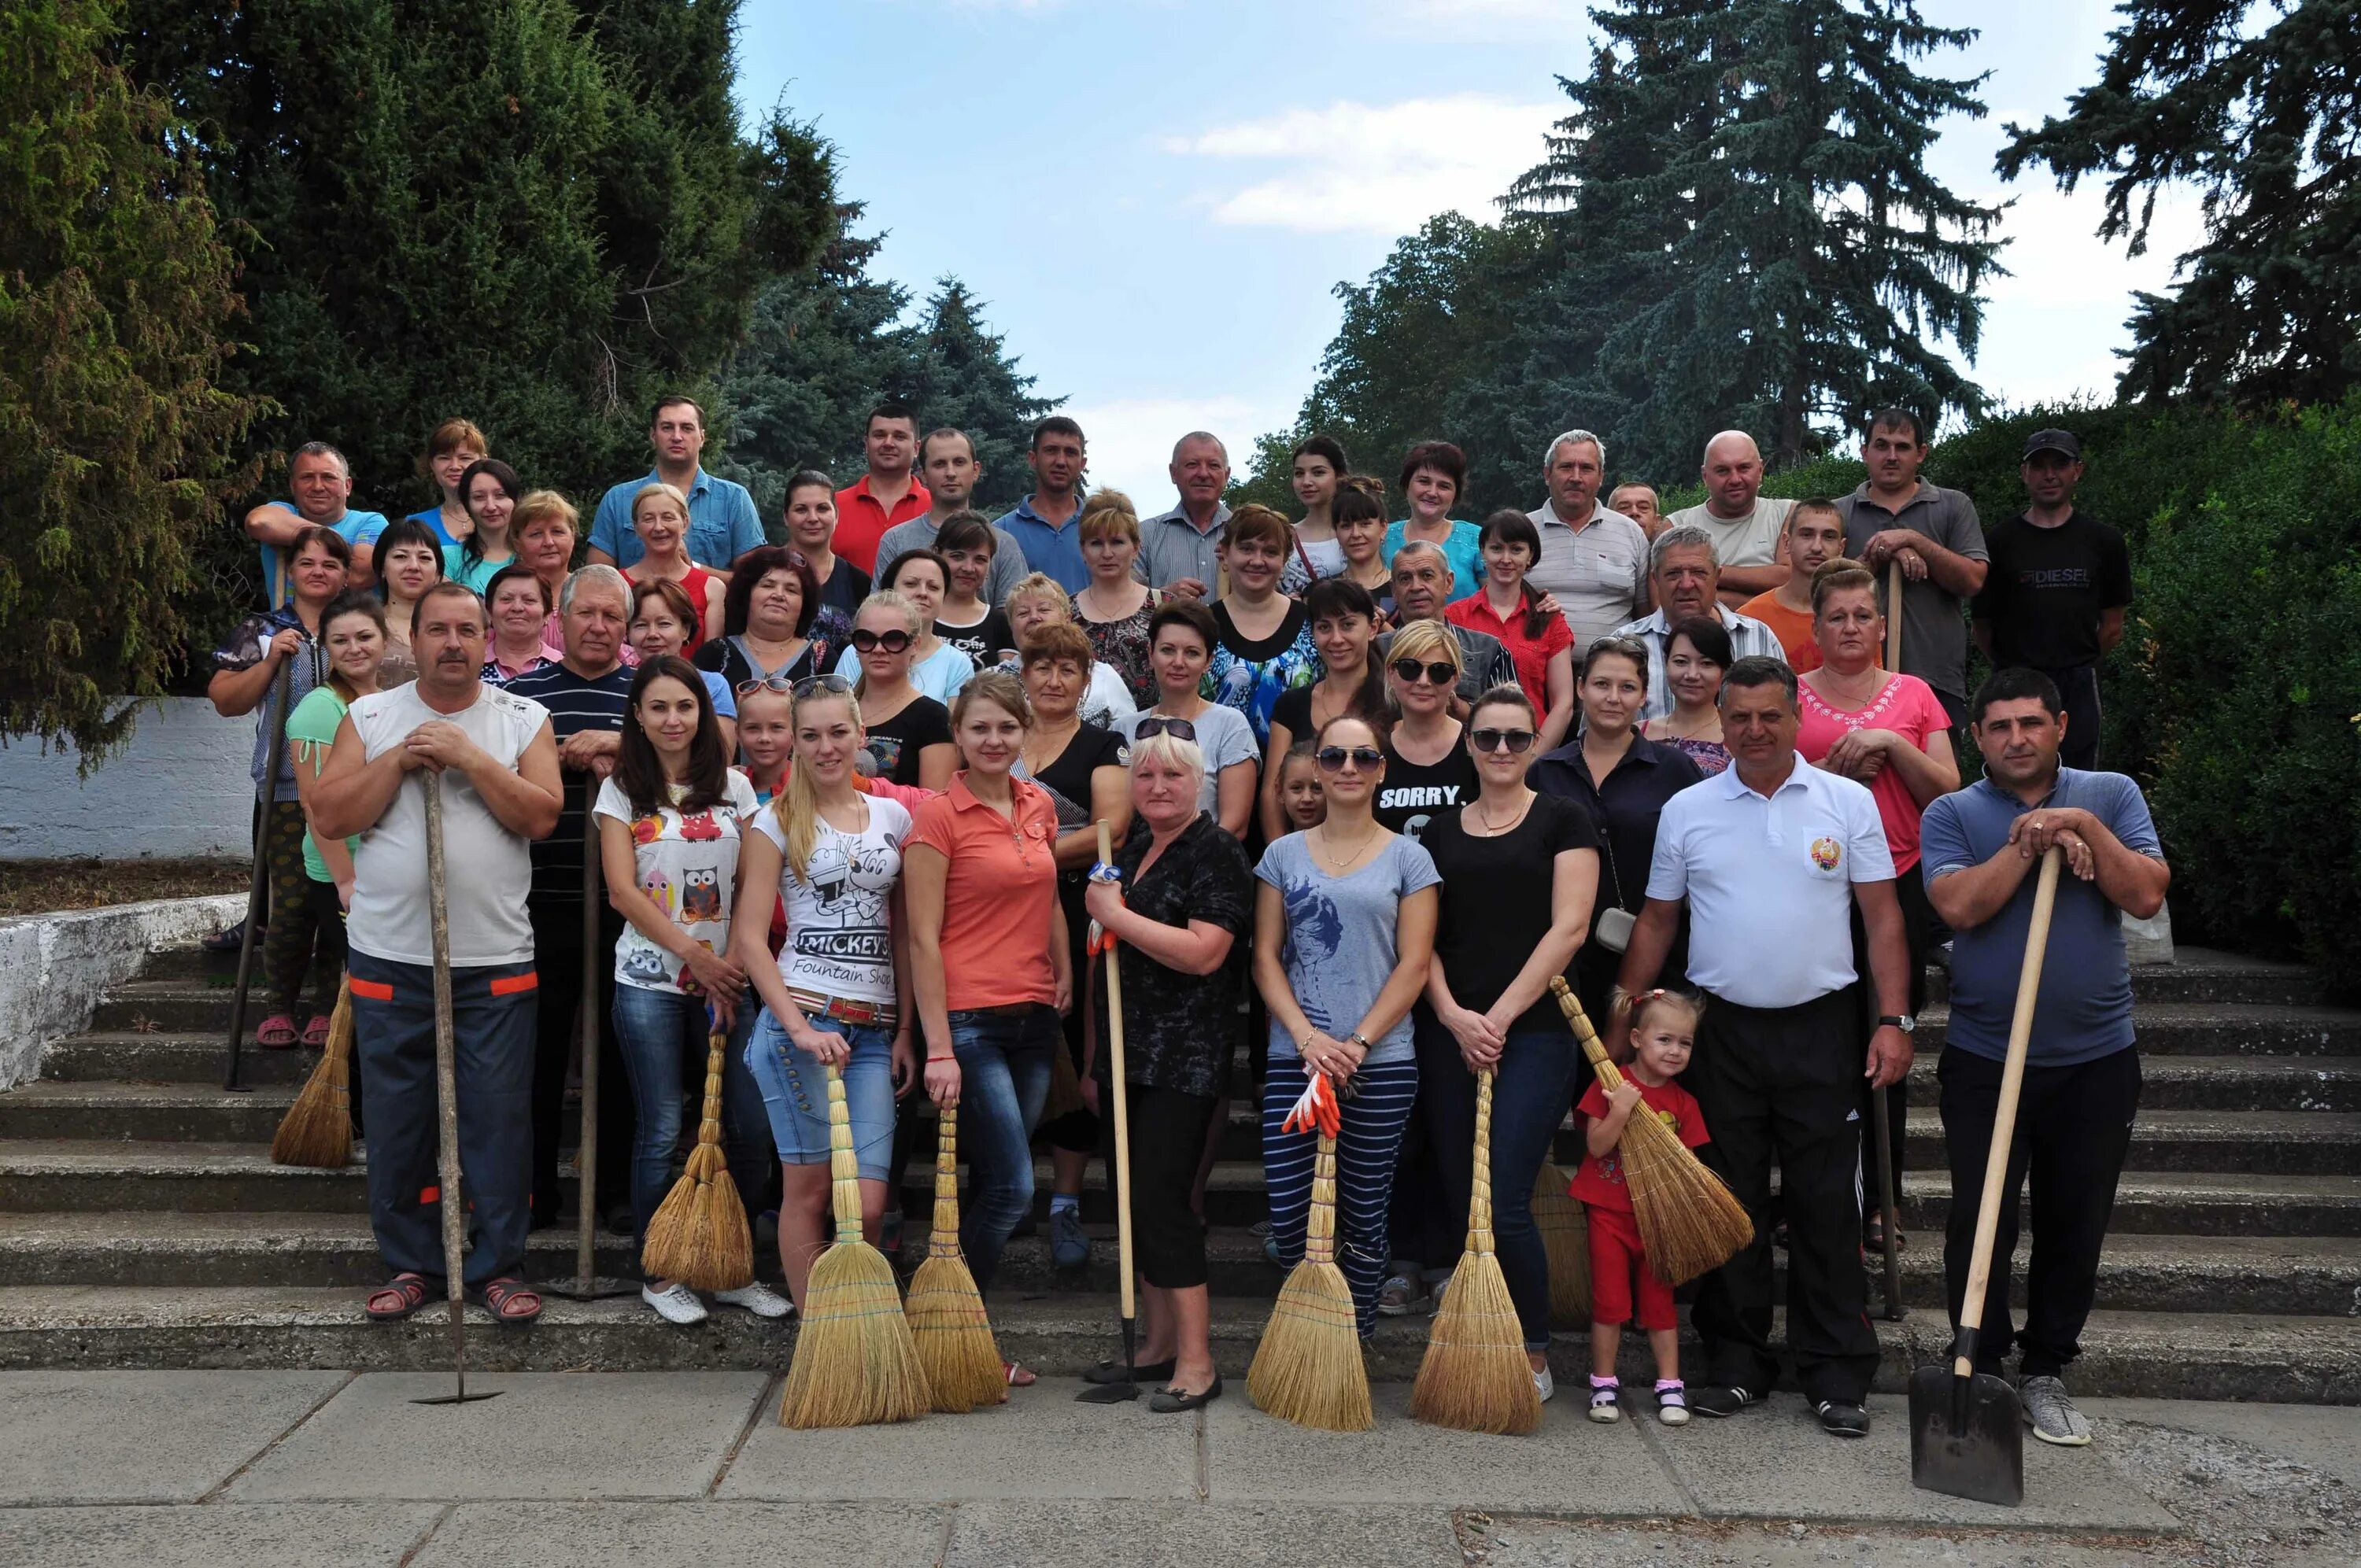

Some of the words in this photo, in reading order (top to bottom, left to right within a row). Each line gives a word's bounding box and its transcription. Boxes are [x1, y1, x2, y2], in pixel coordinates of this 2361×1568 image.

[2035, 568, 2090, 583] DIESEL
[806, 935, 889, 955] MICKEY'S
[793, 959, 863, 982] Fountain
[869, 968, 891, 989] Shop
